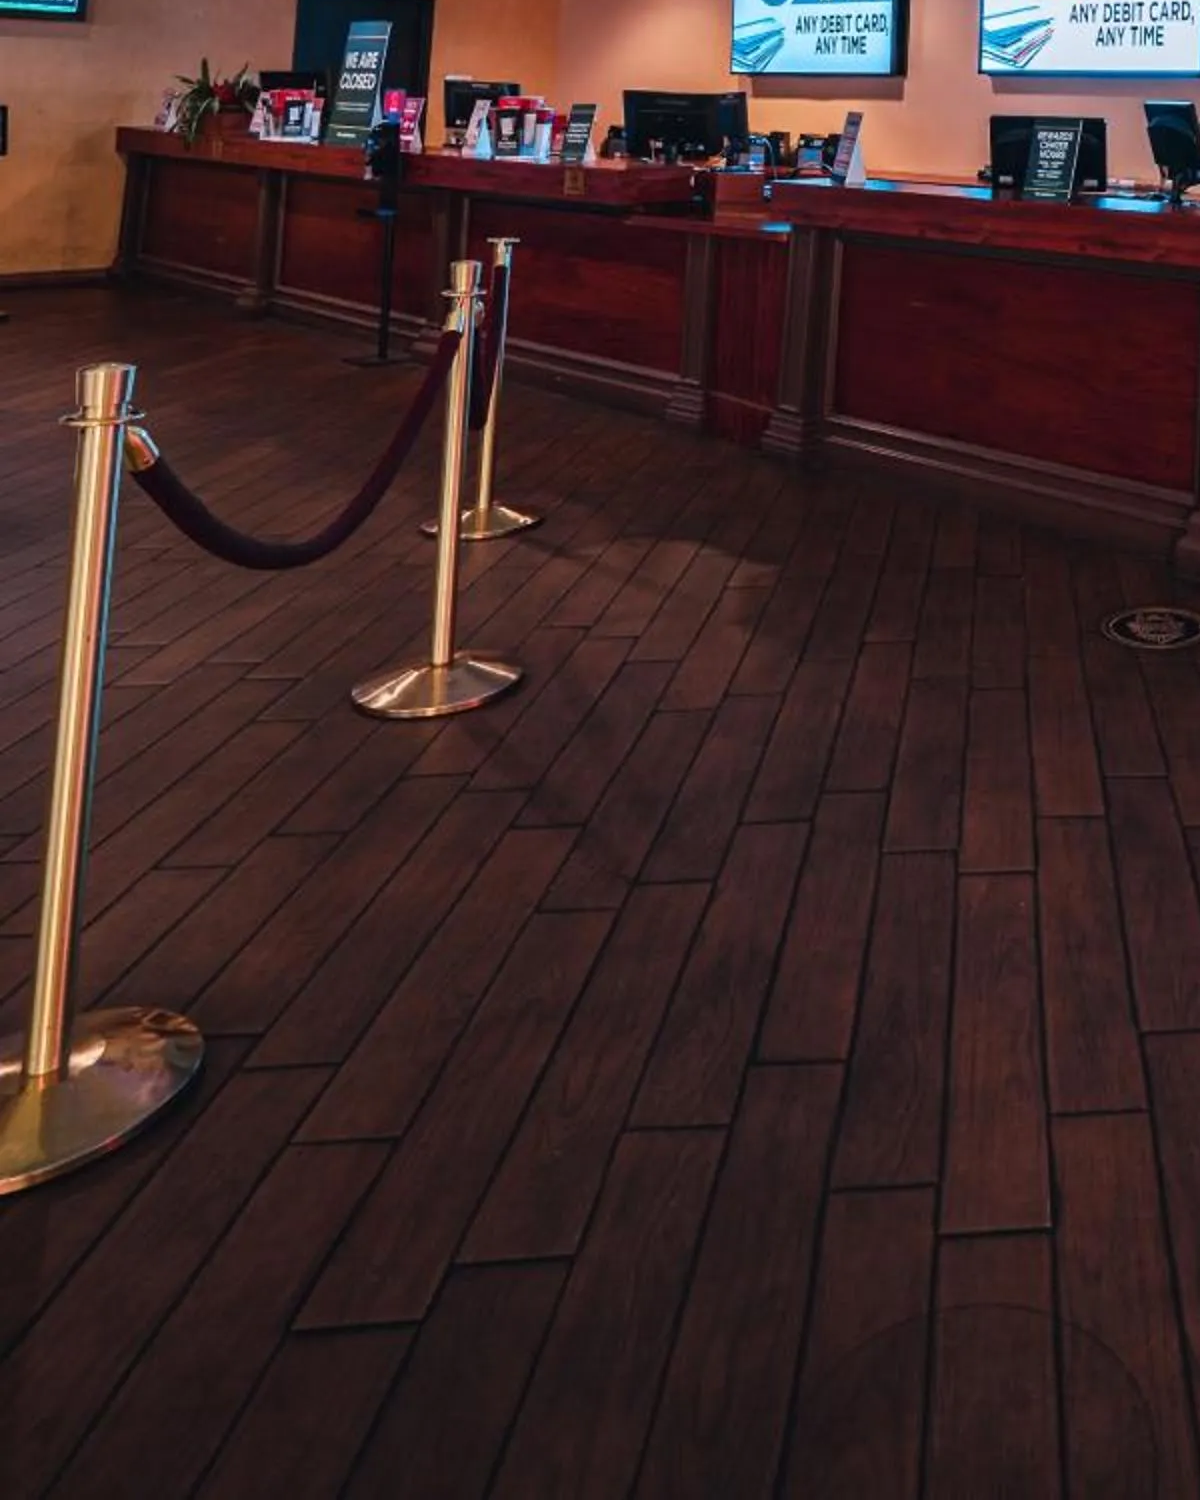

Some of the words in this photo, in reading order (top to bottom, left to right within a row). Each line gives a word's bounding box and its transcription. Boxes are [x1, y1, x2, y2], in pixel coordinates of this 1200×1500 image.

[795, 15, 818, 35] ANY
[820, 14, 853, 34] DEBIT
[855, 11, 889, 36] CARD,
[1069, 2, 1099, 23] ANY
[1103, 1, 1144, 23] DEBIT
[1149, 0, 1196, 26] CARD,
[814, 36, 838, 56] ANY
[840, 35, 867, 55] TIME
[1095, 26, 1128, 47] ANY
[1131, 25, 1165, 47] TIME
[340, 72, 378, 90] CLOSED
